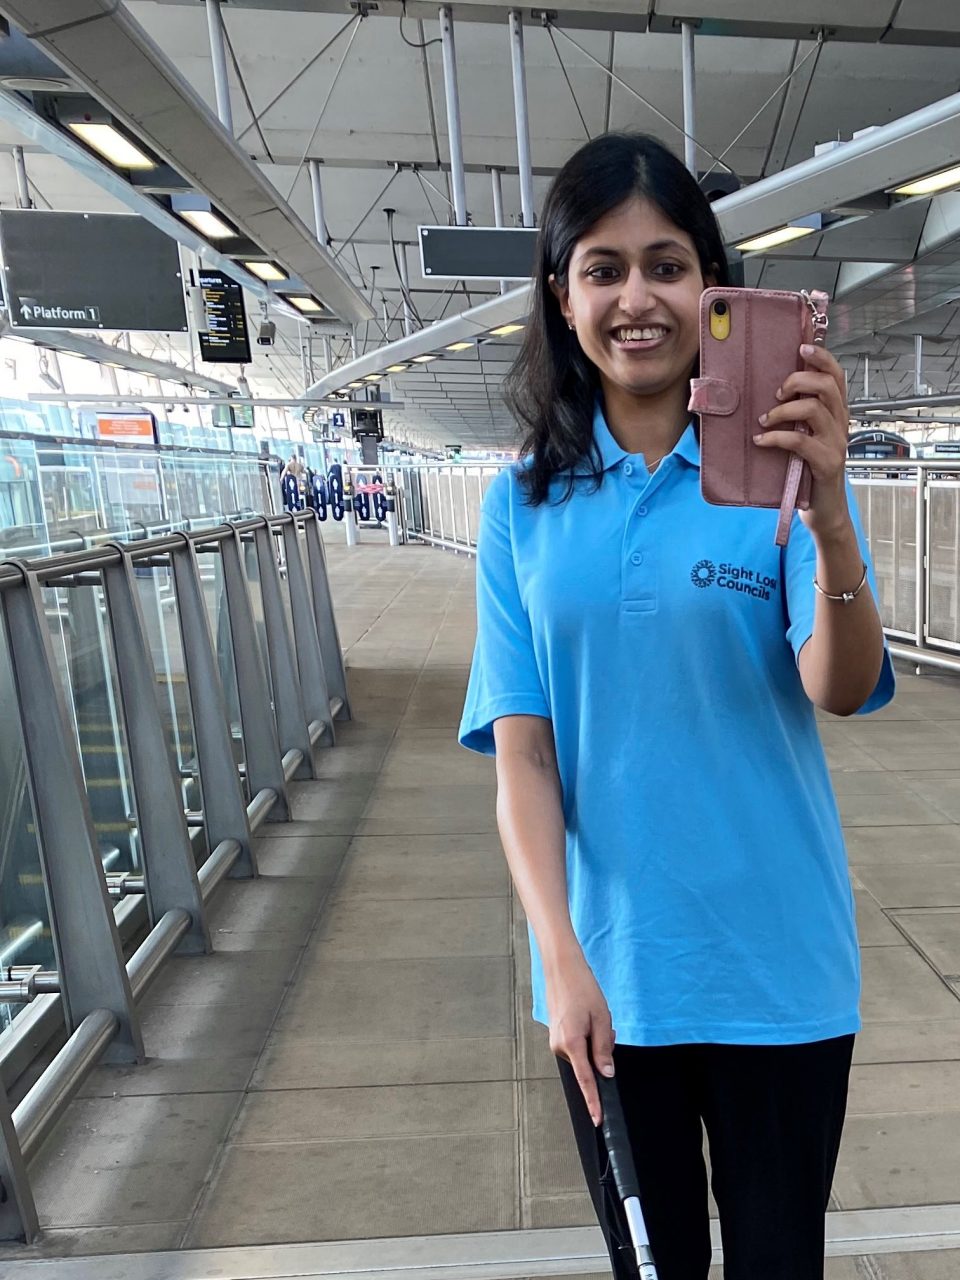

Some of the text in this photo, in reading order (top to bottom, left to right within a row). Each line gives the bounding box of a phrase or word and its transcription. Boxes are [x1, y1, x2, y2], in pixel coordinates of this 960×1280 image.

[33, 306, 96, 320] Platform 1
[335, 414, 343, 425] 1
[718, 563, 753, 581] Sight
[716, 576, 770, 601] Councils
